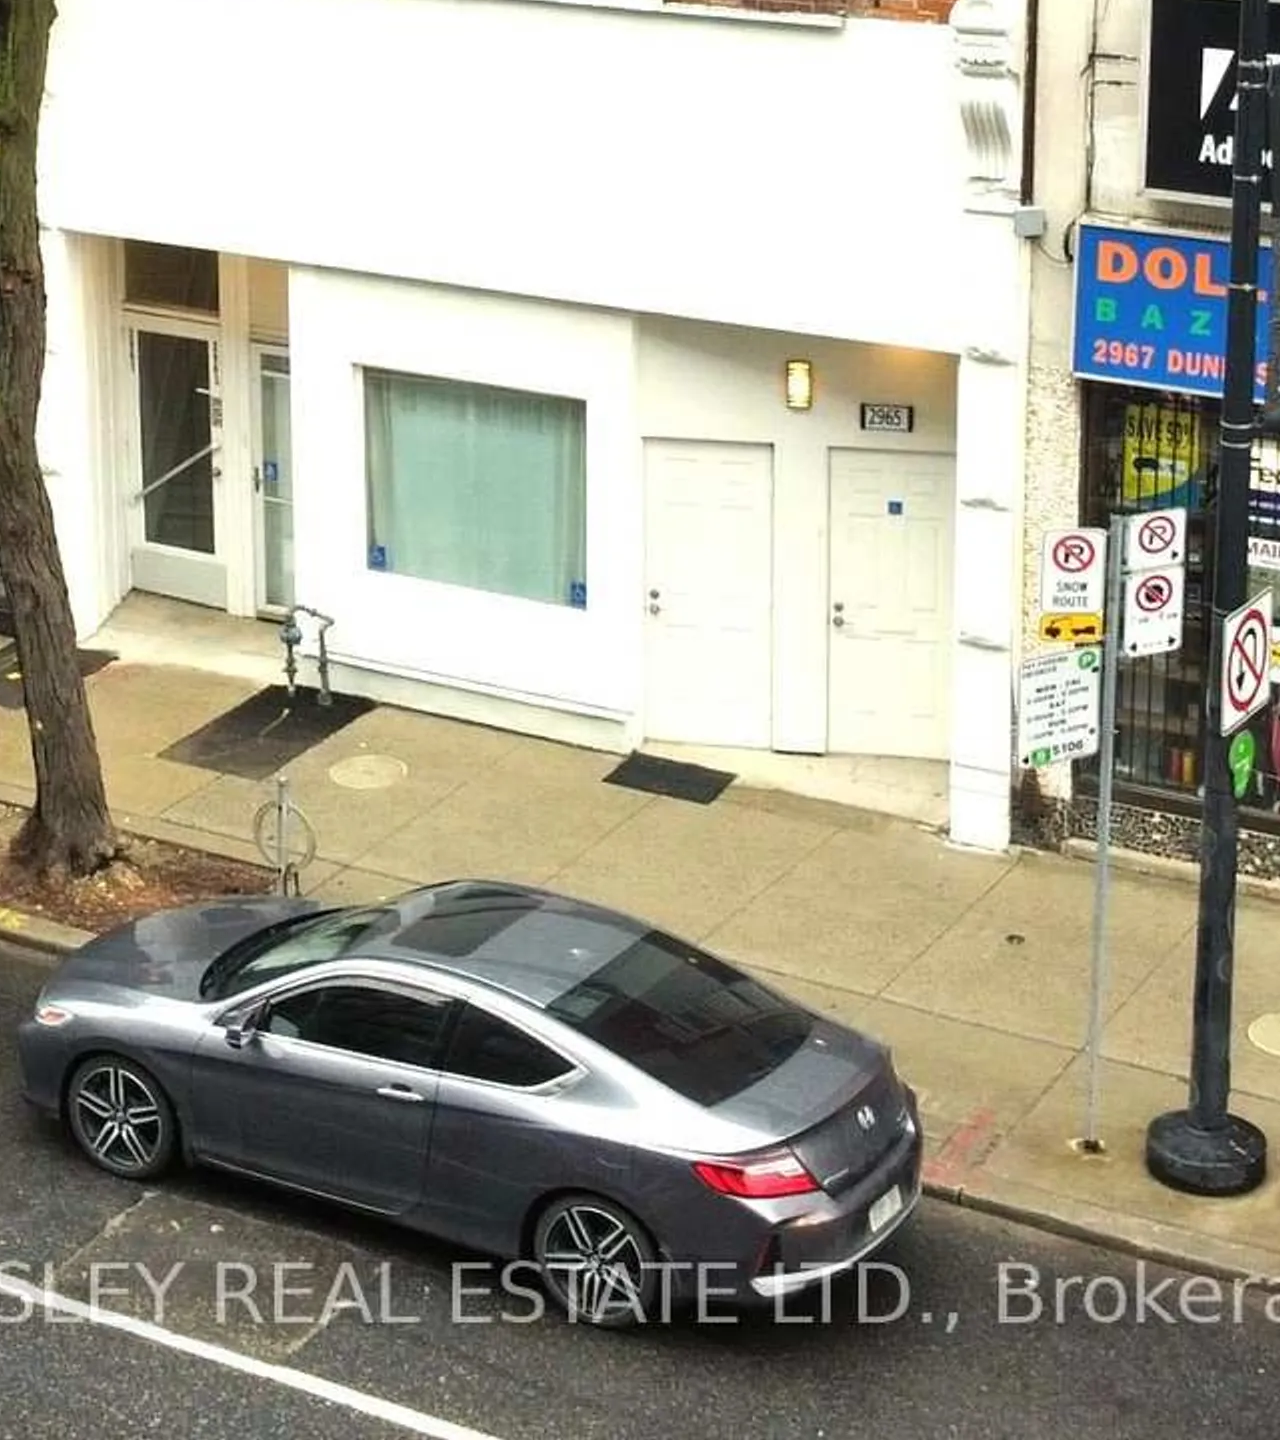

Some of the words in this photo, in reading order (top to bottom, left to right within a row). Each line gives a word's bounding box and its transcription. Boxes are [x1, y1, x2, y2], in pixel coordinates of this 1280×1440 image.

[1093, 337, 1156, 370] 2967
[869, 408, 902, 427] 2965
[1055, 580, 1089, 594] SNOW
[1052, 595, 1089, 609] ROUTE
